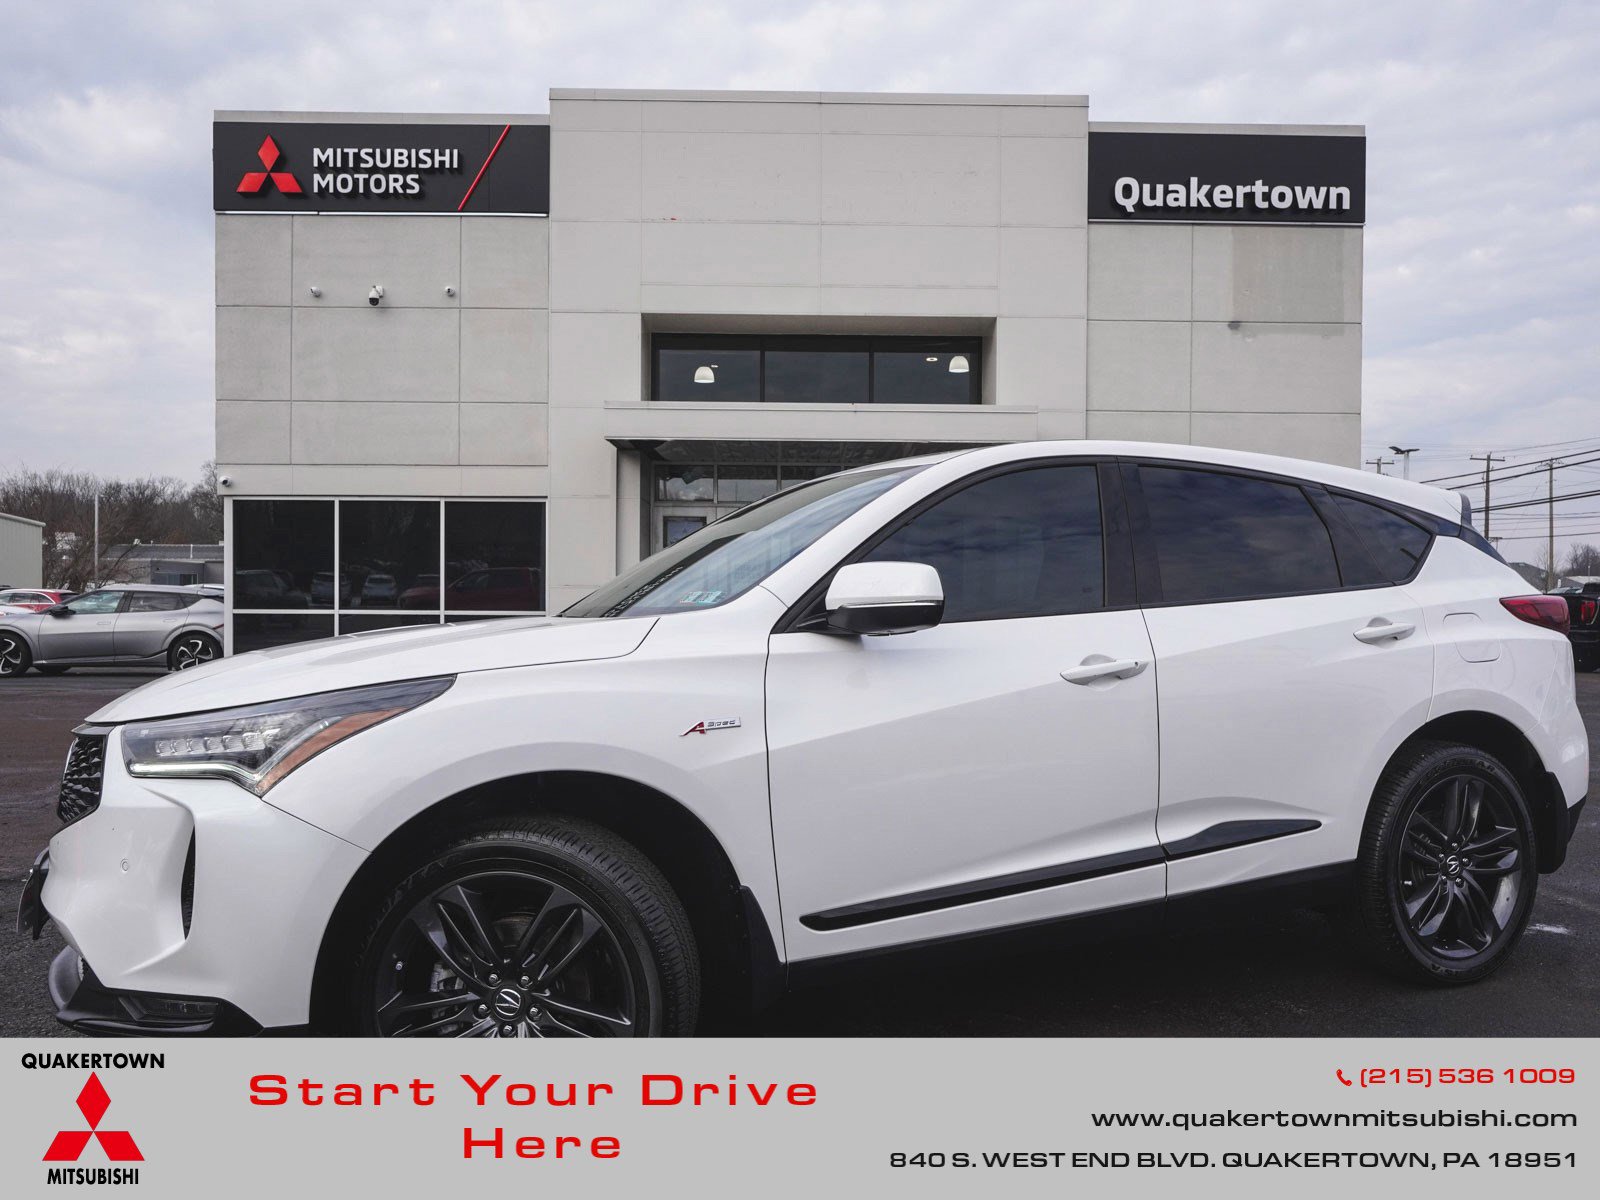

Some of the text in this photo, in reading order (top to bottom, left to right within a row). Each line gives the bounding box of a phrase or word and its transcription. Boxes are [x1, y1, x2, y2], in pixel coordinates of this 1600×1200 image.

[313, 147, 459, 169] MITSUBISHI
[313, 173, 420, 195] MOTORS
[1115, 176, 1350, 212] Quakertown
